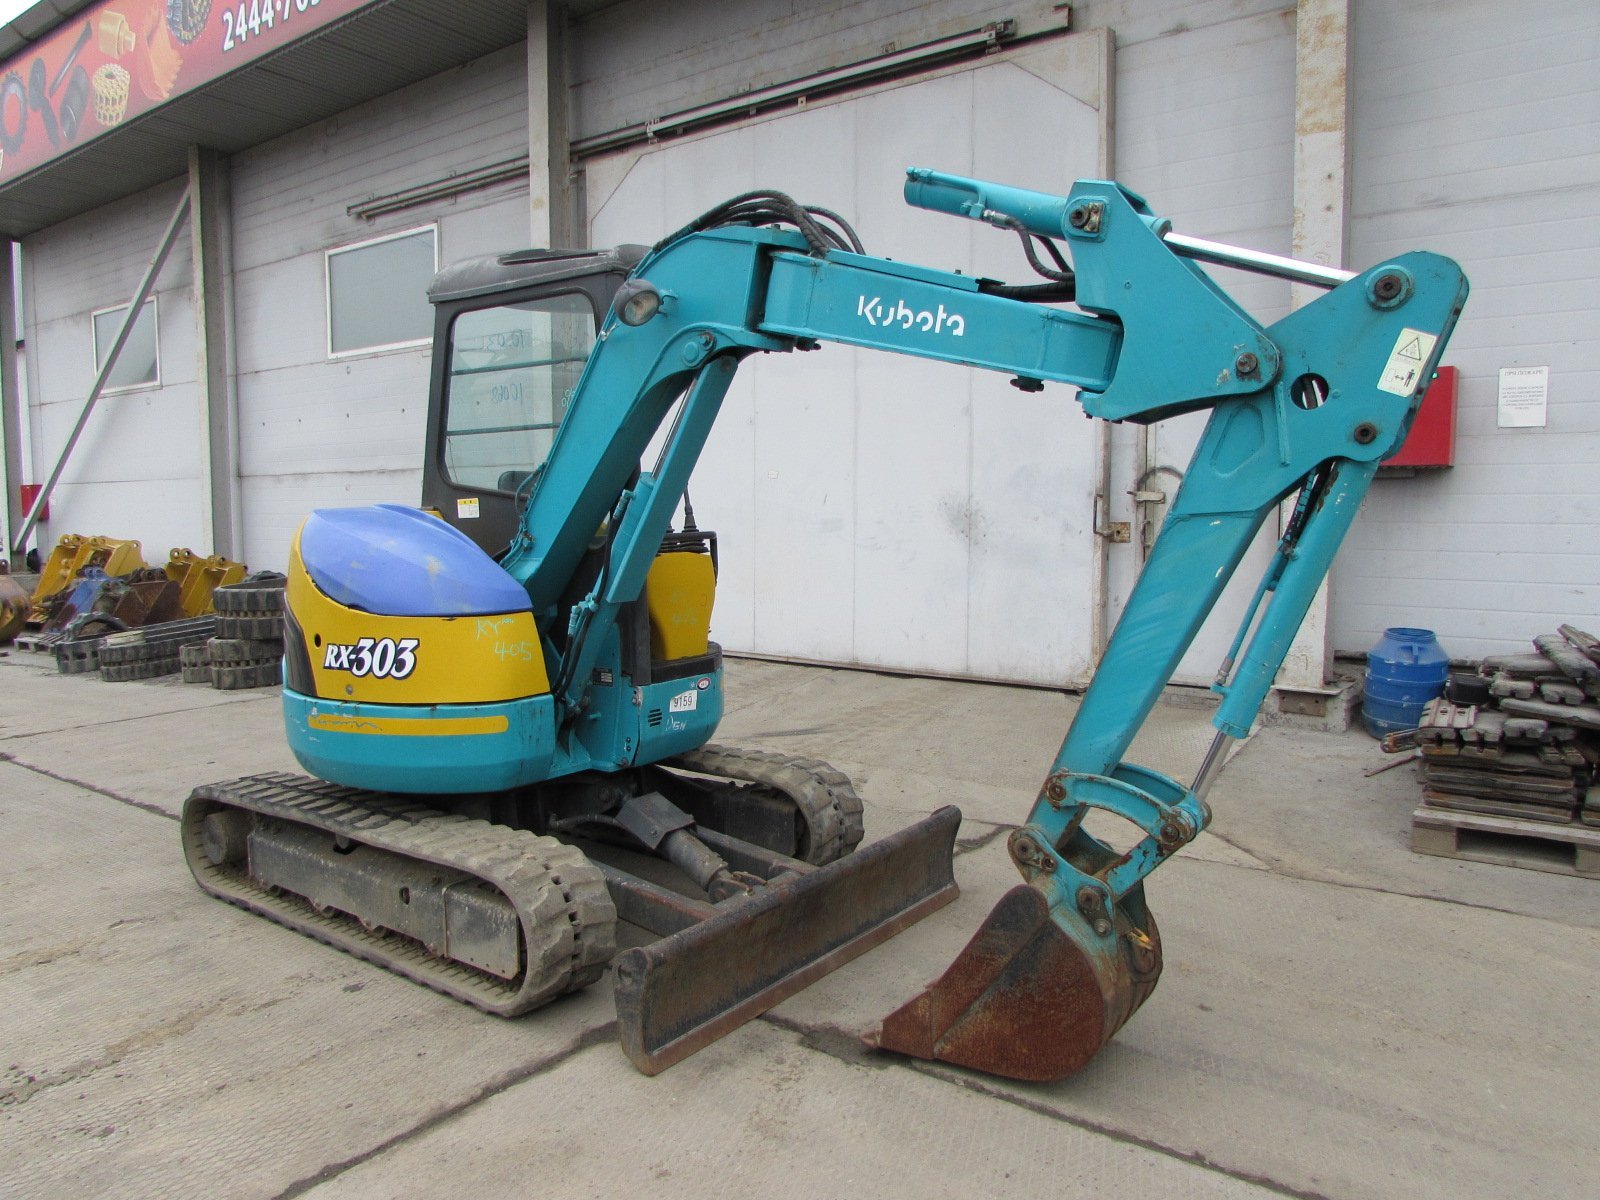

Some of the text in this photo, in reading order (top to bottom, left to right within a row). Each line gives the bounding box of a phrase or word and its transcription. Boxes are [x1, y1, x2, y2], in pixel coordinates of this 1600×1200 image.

[857, 295, 965, 337] Kubota
[323, 637, 419, 679] RX-303
[673, 695, 693, 708] 9159
